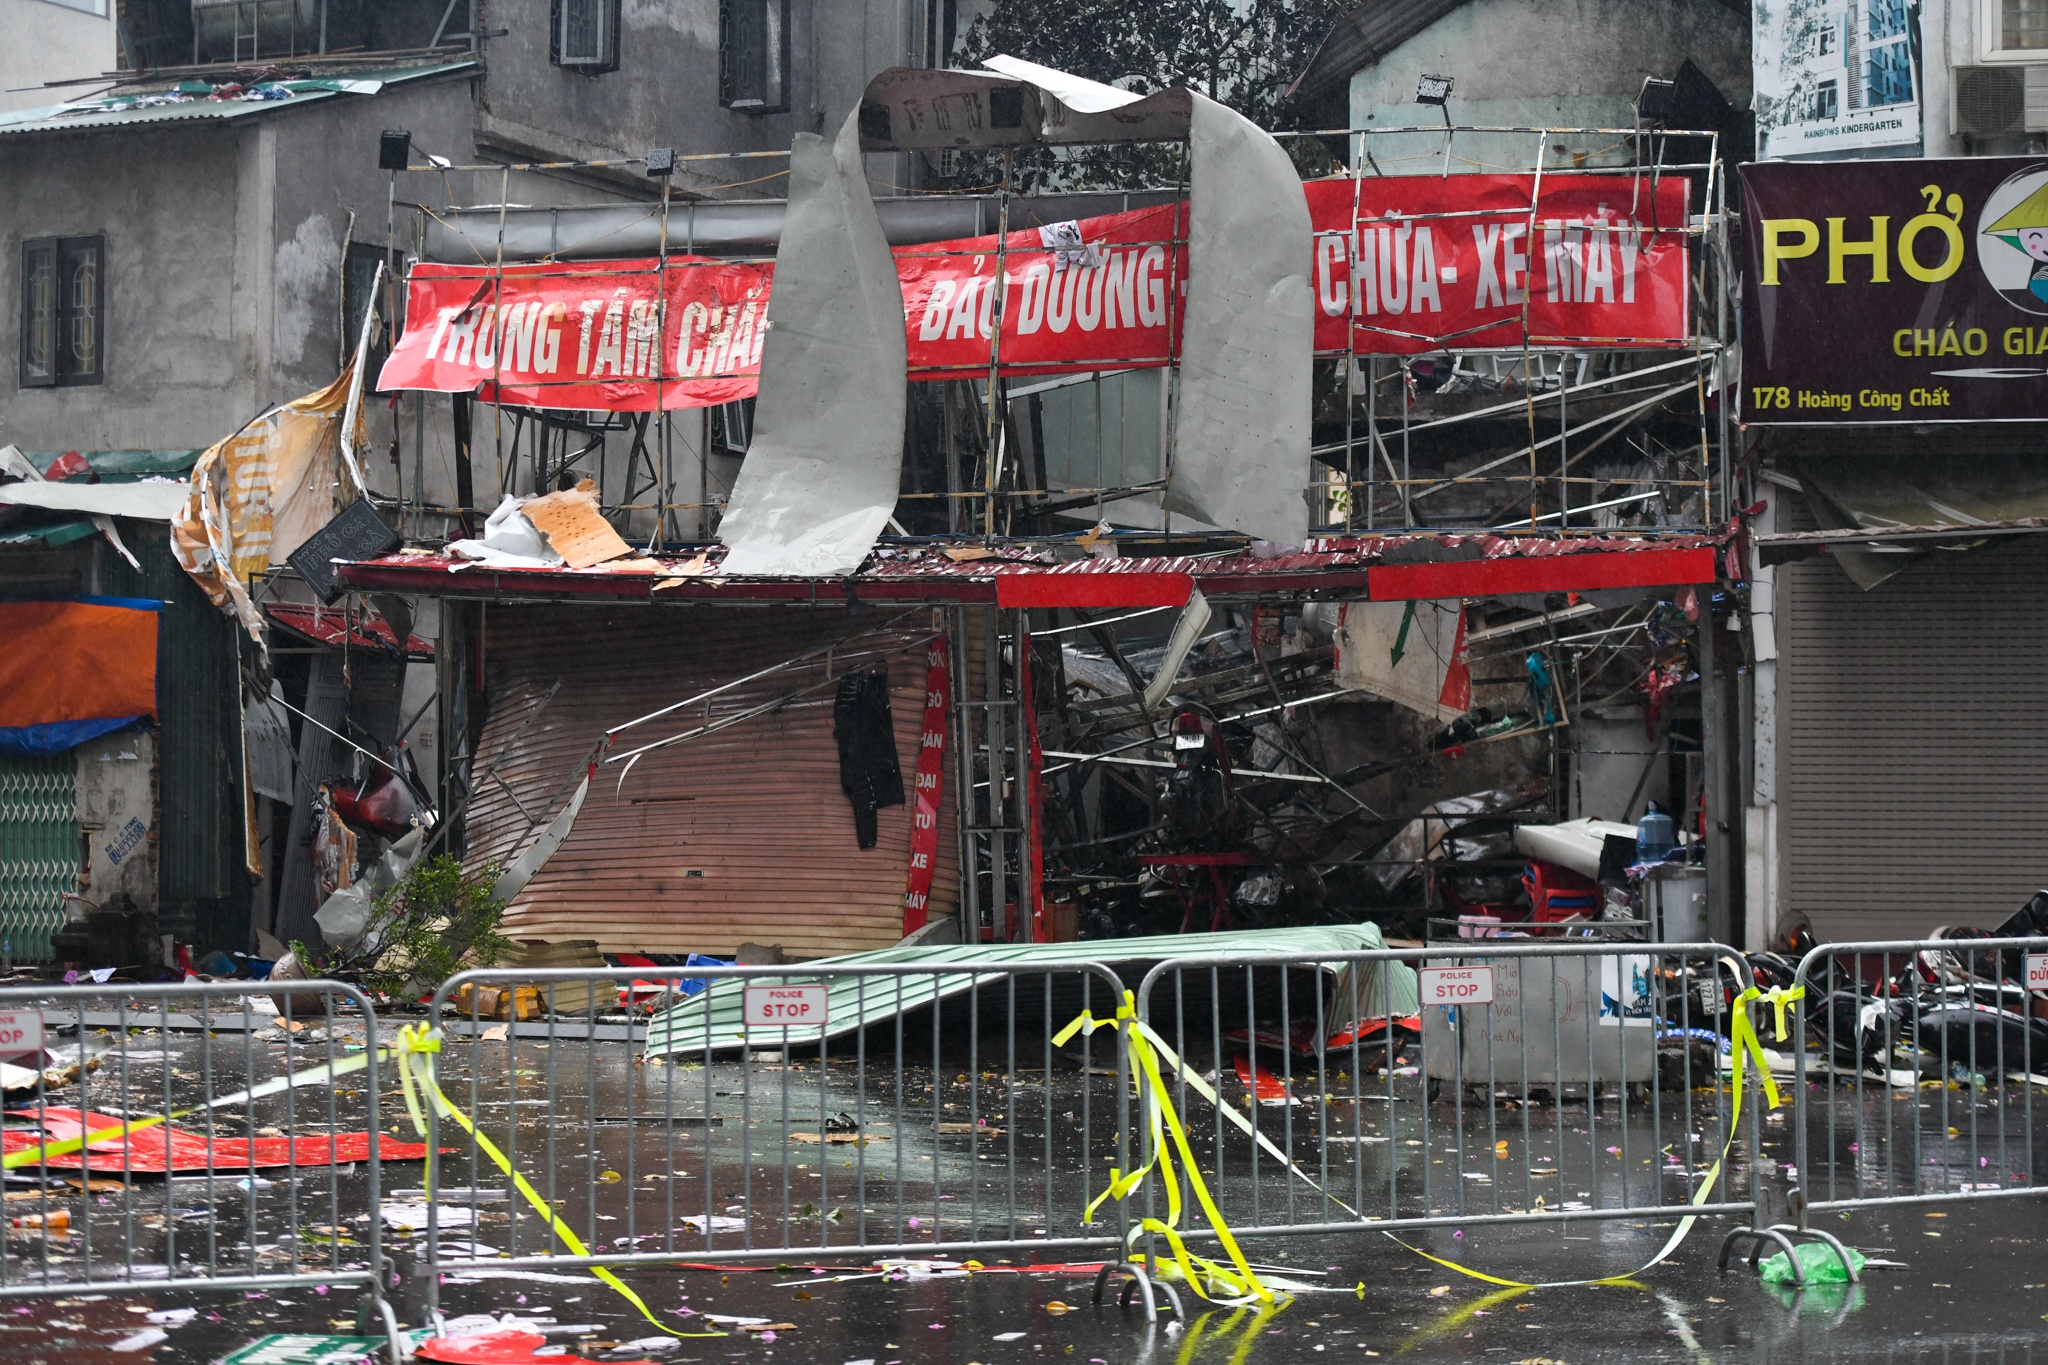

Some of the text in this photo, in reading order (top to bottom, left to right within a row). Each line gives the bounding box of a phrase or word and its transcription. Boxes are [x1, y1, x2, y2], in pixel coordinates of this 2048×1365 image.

[1804, 119, 1903, 139] RAINBOWS KINDERGARTEN
[1760, 184, 1965, 286] PHỞ
[425, 301, 566, 375] TRUNG
[576, 286, 667, 378] TÂM
[918, 254, 1011, 342] BẢO
[1471, 222, 1530, 309] XE
[1543, 202, 1643, 304] MÁY
[1893, 321, 1988, 357] CHÁO
[1752, 386, 1950, 412] 178 Hoàng Công Chất
[915, 813, 931, 830] TU
[911, 853, 927, 869] XE
[1440, 971, 1473, 980] POLICE
[769, 990, 803, 999] POLICE
[1436, 983, 1479, 998] STOP
[763, 1003, 810, 1018] STOP
